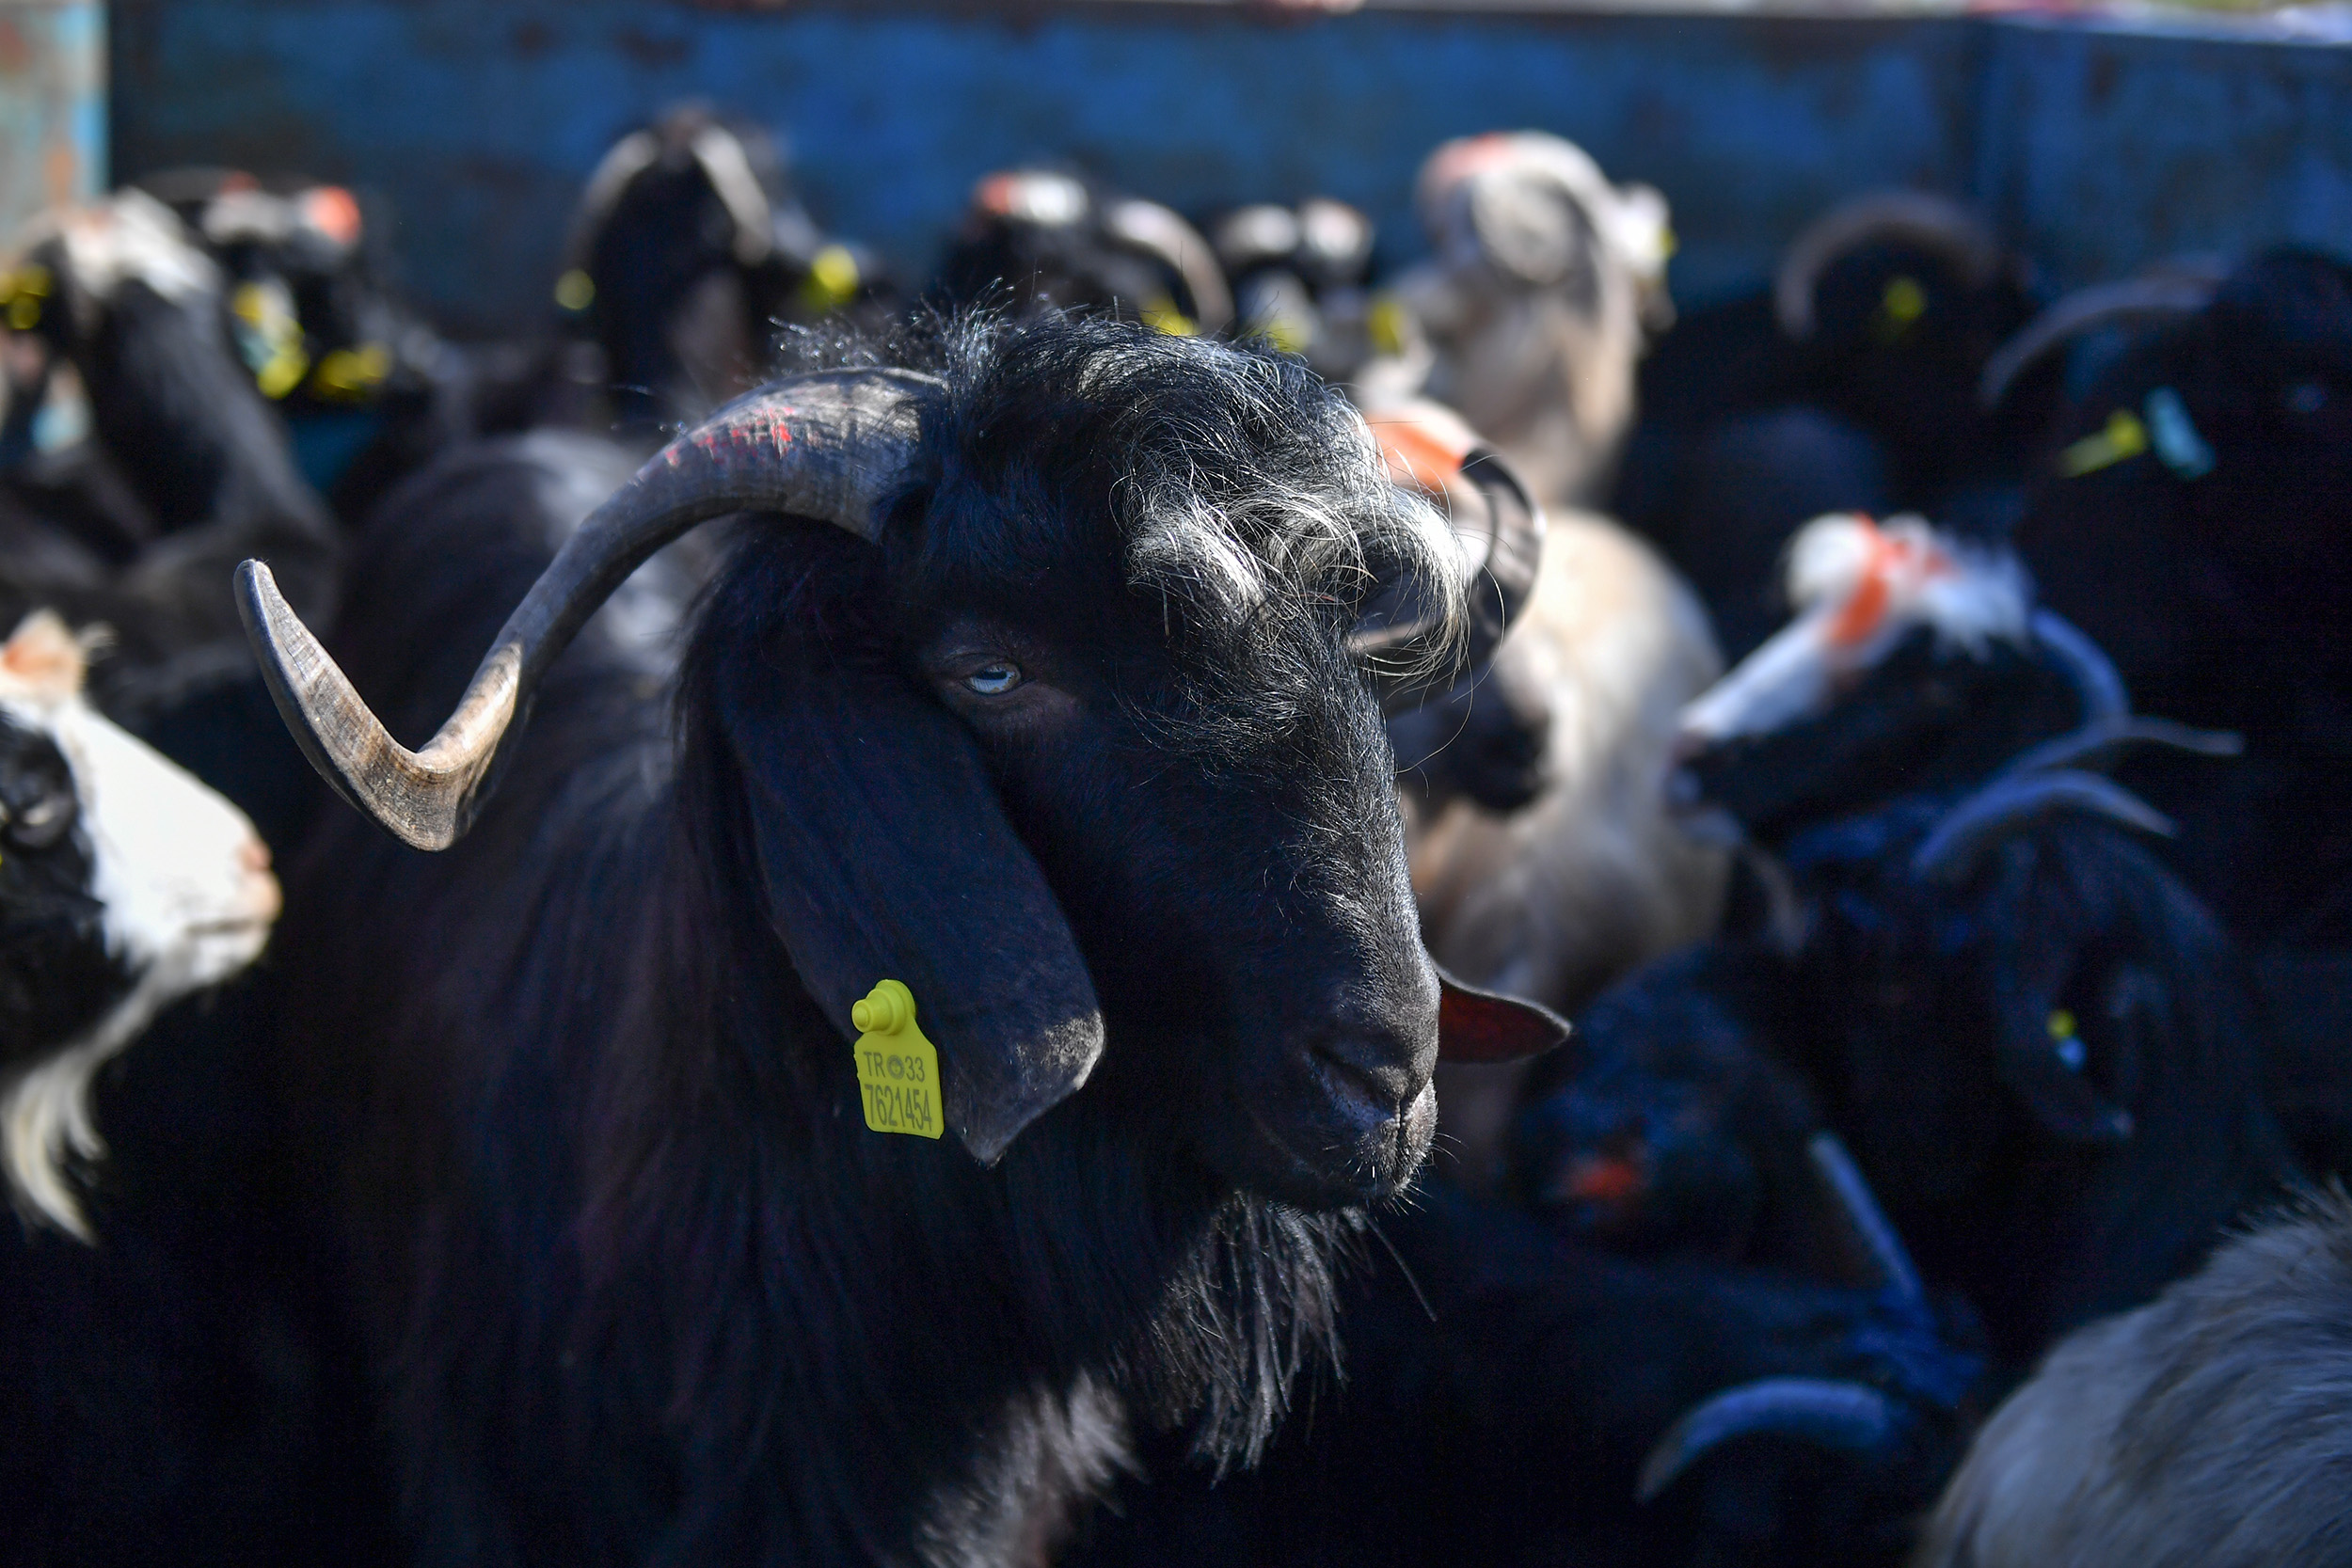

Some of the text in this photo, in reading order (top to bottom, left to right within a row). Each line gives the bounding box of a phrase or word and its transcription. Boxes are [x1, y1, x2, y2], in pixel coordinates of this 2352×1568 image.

[864, 1052, 925, 1083] TR 33
[865, 1084, 932, 1132] 7621454
